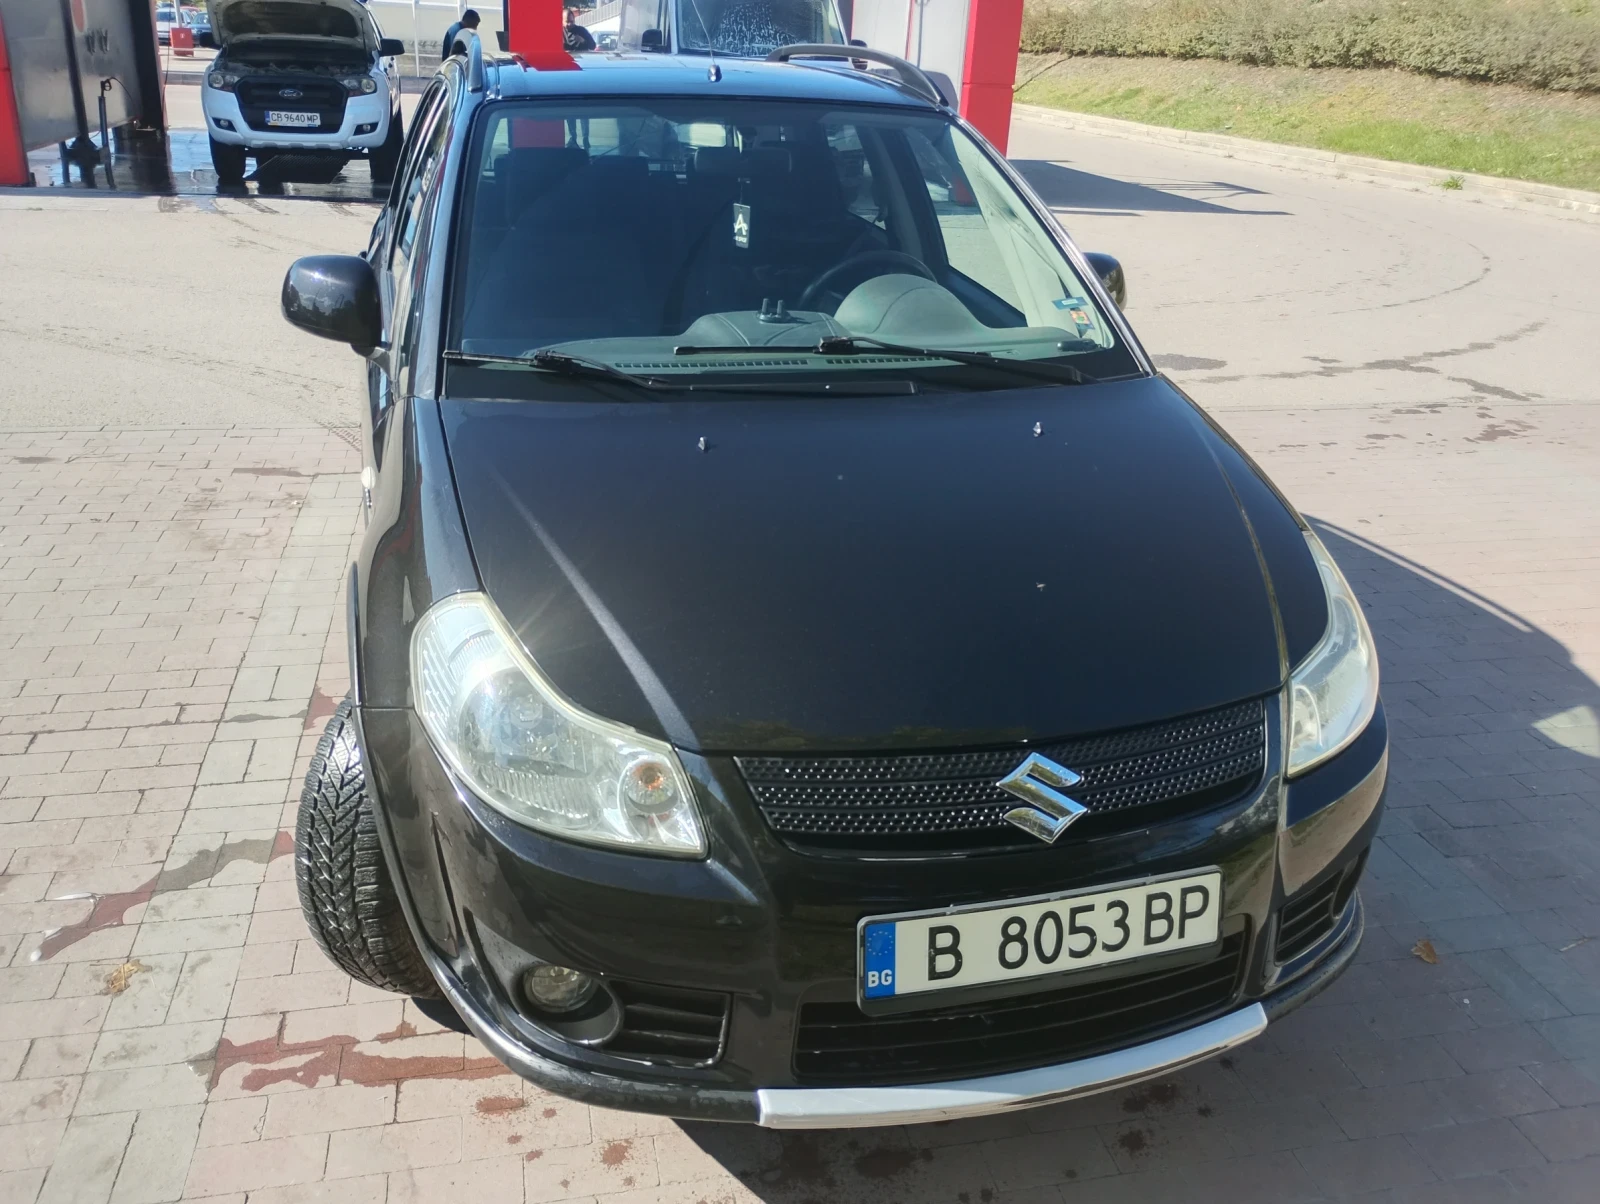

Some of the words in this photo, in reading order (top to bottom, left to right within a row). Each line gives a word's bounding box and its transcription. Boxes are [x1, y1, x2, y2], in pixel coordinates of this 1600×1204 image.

[271, 112, 283, 122] CB
[284, 113, 306, 123] 9640
[306, 115, 319, 123] MP
[927, 924, 963, 981] B
[997, 899, 1131, 970] 8053
[1143, 884, 1210, 946] BP
[867, 969, 893, 988] BG
